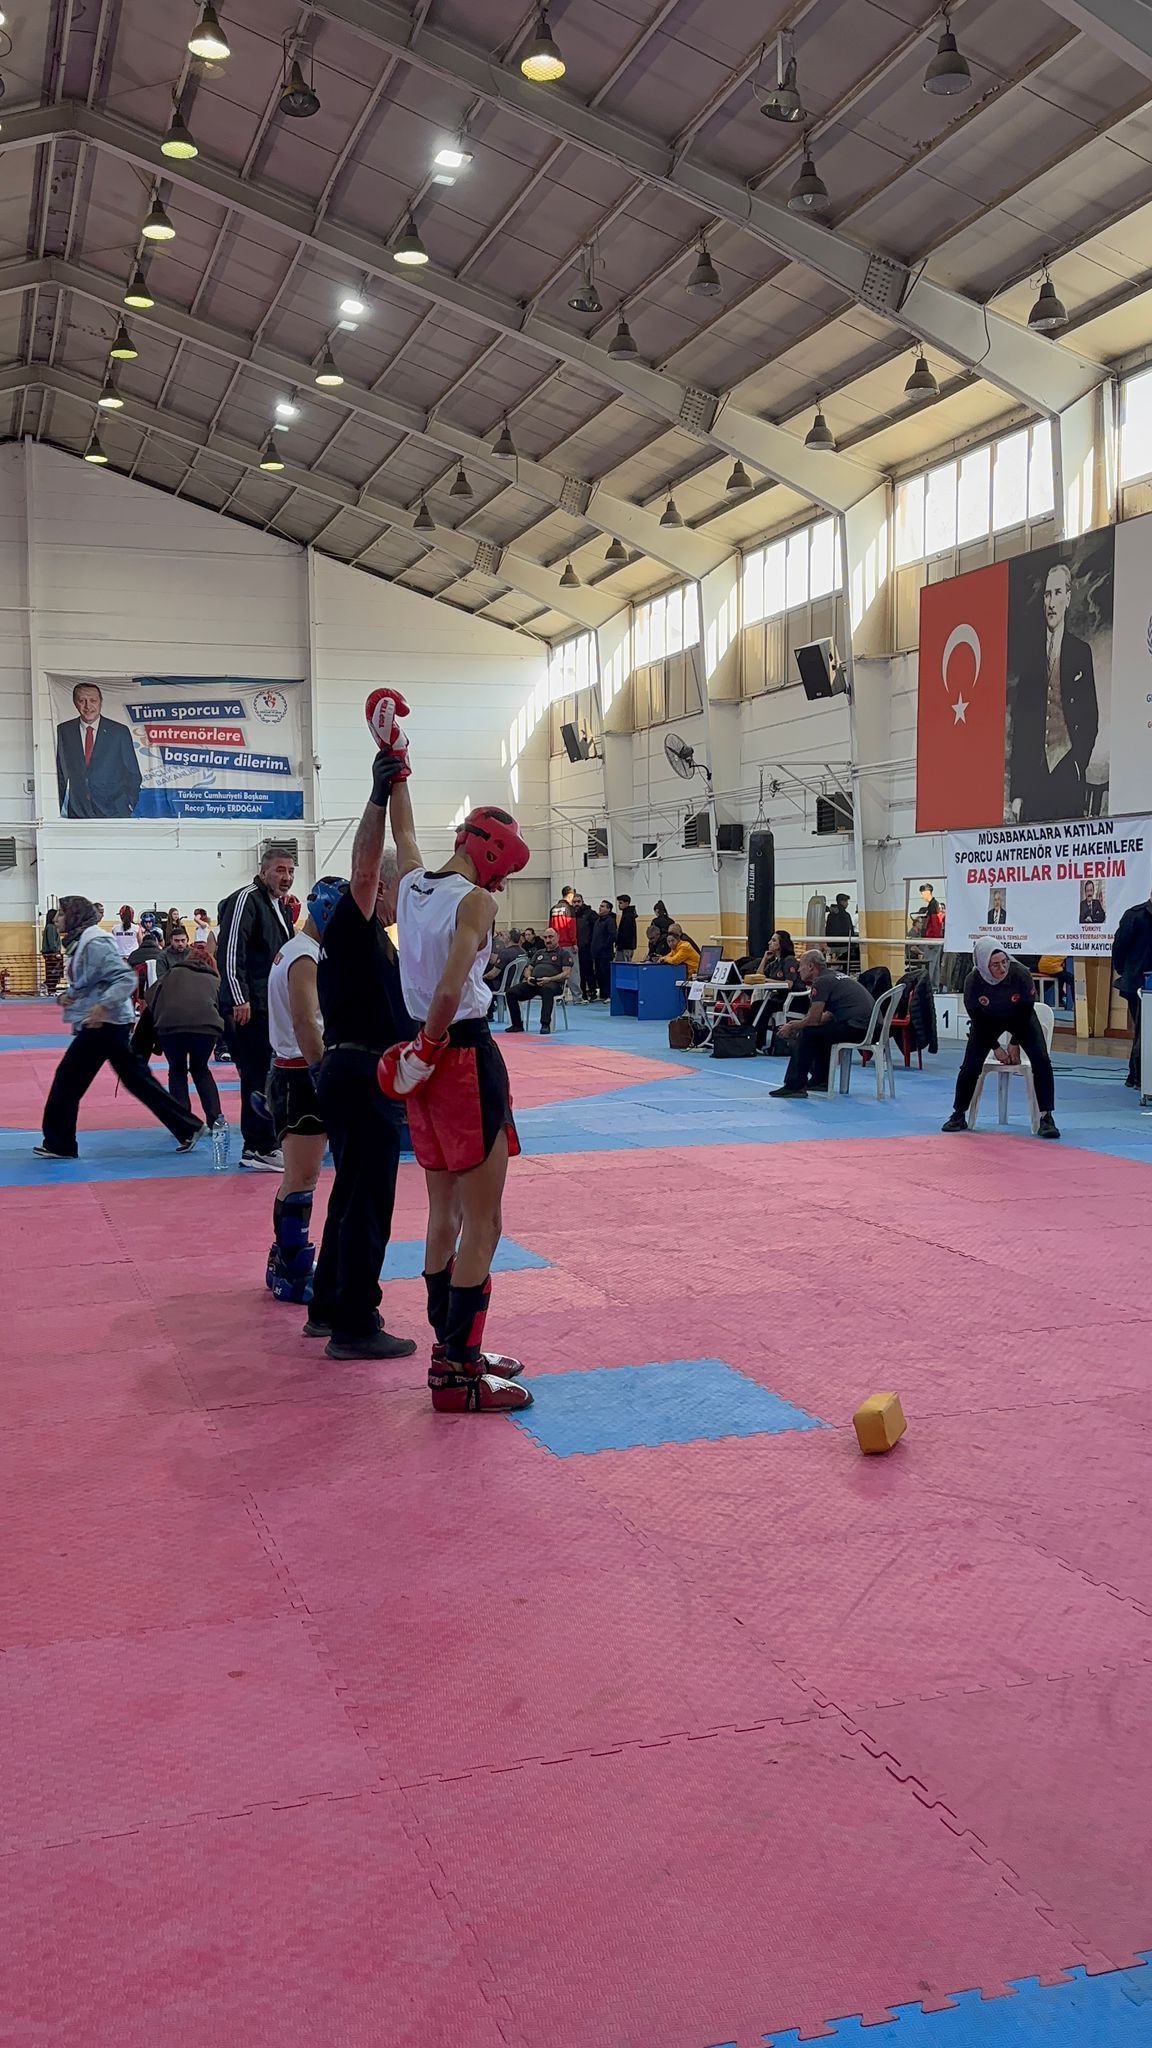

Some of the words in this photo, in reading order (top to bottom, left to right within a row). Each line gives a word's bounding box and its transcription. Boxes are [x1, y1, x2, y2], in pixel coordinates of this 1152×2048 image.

[131, 705, 166, 719] Tüm
[171, 704, 220, 718] sporcu
[225, 704, 240, 715] ve
[149, 728, 241, 742] antrenörlere
[165, 748, 229, 765] başarılar
[234, 754, 288, 770] dilerim.
[178, 791, 202, 800] Türkiye
[204, 791, 242, 801] Cumhuriyeti
[244, 792, 269, 802] Başkanı
[185, 804, 205, 813] Recep
[206, 804, 226, 814] Tayyip
[978, 828, 1061, 845] MÜSABAKALARA
[1064, 821, 1114, 838] KATILAN
[955, 850, 992, 864] SPORCU
[996, 844, 1051, 862] ANTRENÖR
[1055, 845, 1069, 857] VE
[1072, 838, 1144, 856] HAKEMLERE
[967, 864, 1051, 887] BAŞARILAR
[1057, 857, 1126, 880] DİLERİM
[1071, 941, 1090, 950] SALİM
[942, 1010, 949, 1028] 1
